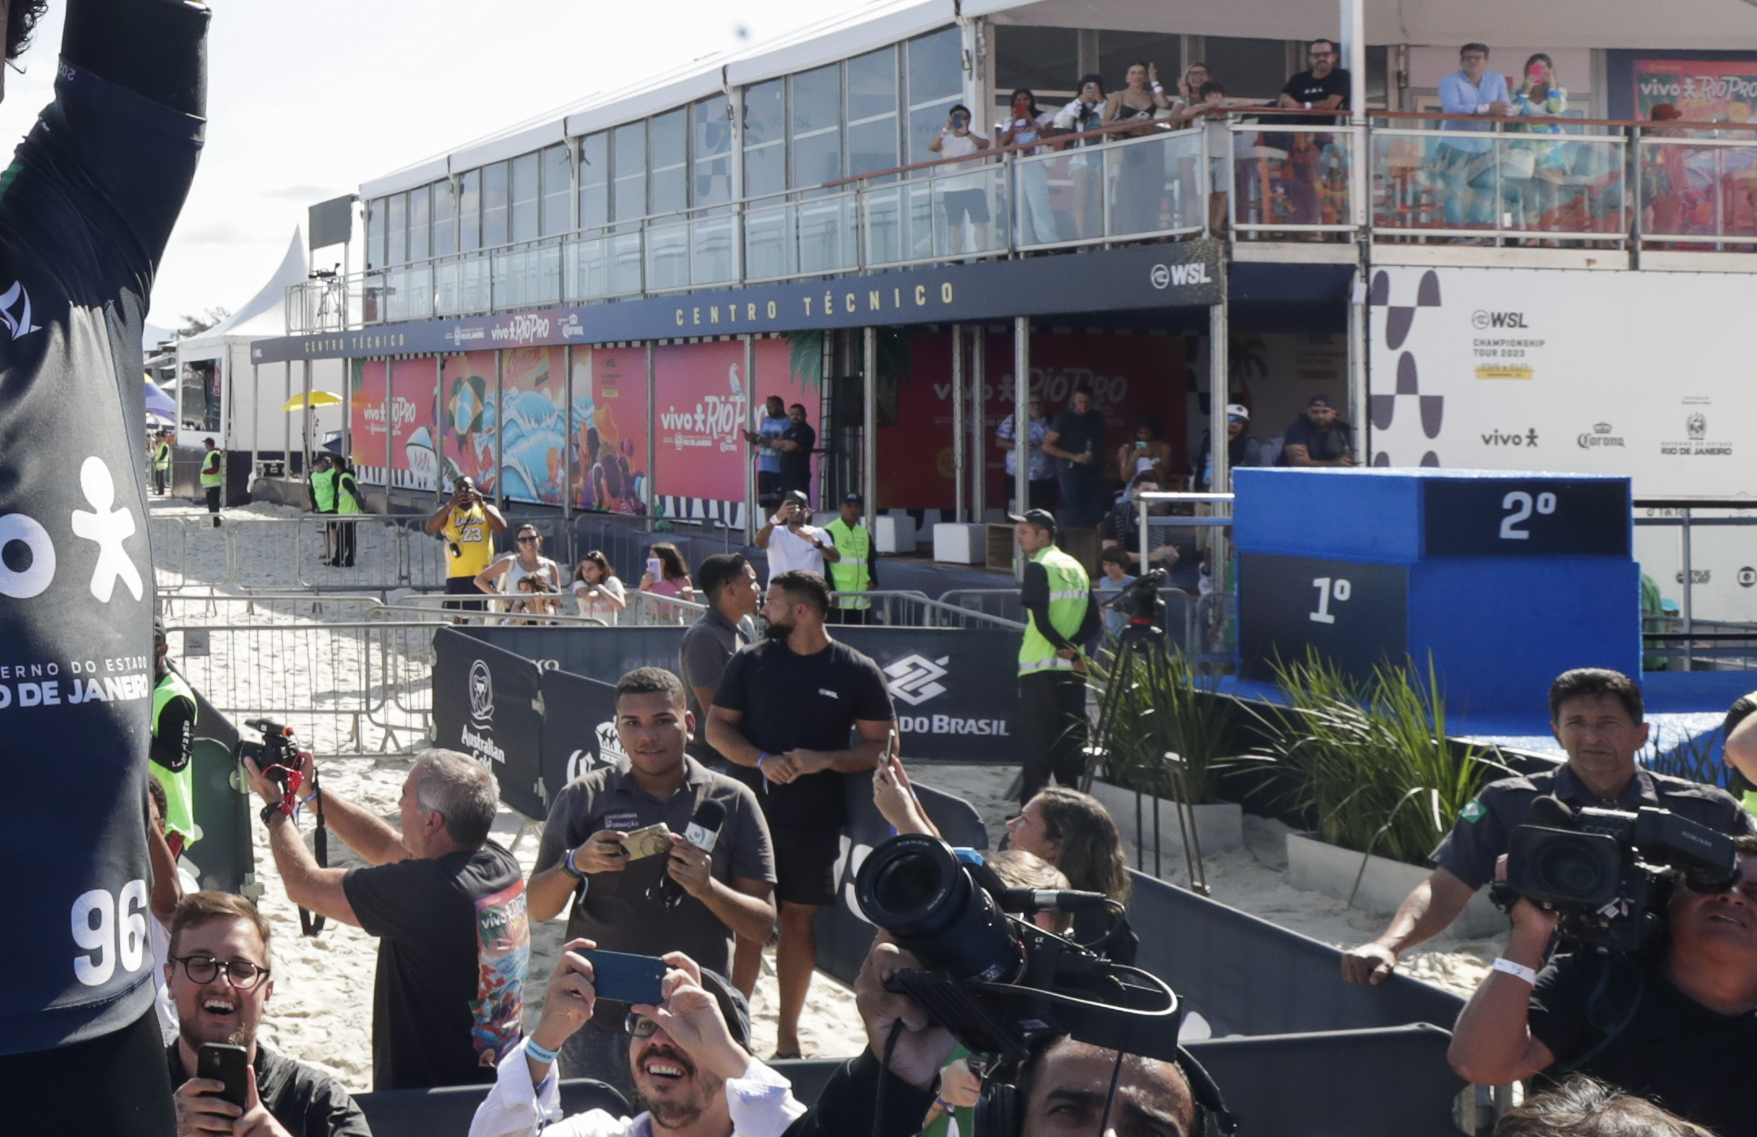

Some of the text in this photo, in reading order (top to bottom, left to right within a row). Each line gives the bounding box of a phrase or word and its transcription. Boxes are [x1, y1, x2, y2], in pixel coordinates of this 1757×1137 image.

[1640, 79, 1681, 96] vivo
[1171, 262, 1212, 286] WSL
[675, 282, 954, 326] CENTRO TÉCNICO
[1491, 312, 1530, 329] WSL
[491, 323, 509, 340] vivo
[305, 333, 404, 353] CENTRO TÉCNICO
[1473, 339, 1546, 348] CHAMPIONSHIP
[1473, 348, 1525, 358] TOUR 2023
[661, 405, 693, 430] vivo
[1481, 429, 1523, 447] vivo
[1577, 433, 1627, 450] Corona
[463, 527, 484, 542] 23
[71, 660, 97, 675] DO
[105, 655, 148, 672] ESTADO
[19, 680, 61, 707] DE
[67, 673, 149, 705] JANEIRO
[899, 716, 929, 733] DO
[461, 724, 506, 764] Australian
[70, 879, 148, 987] 96
